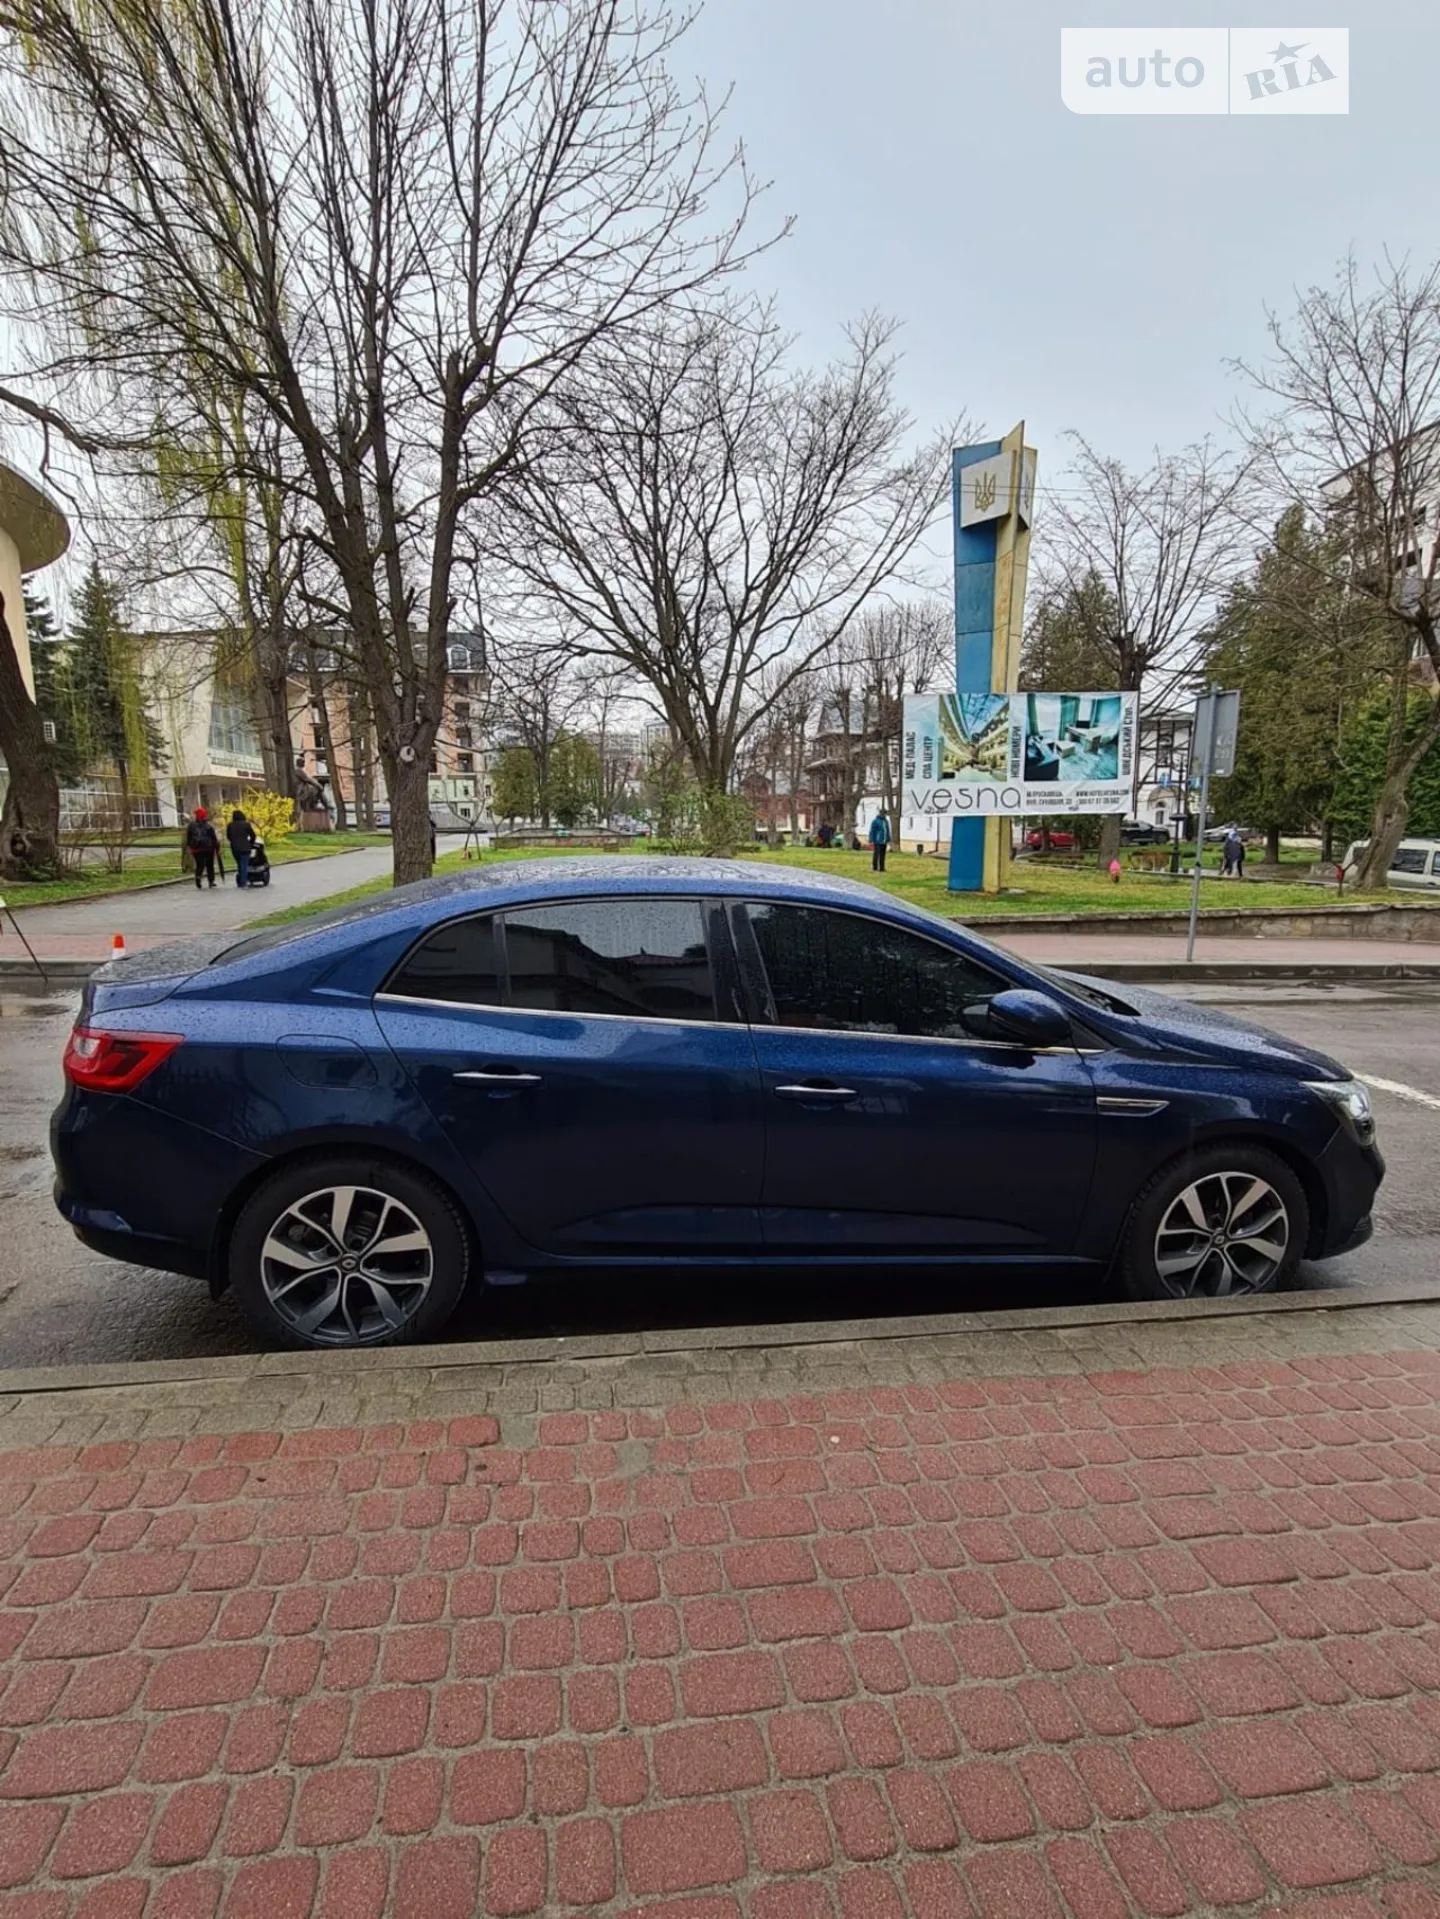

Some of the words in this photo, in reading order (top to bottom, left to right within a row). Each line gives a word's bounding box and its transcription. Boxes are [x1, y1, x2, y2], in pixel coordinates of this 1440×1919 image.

[905, 731, 916, 780] МЕД-ПАЛАС
[923, 735, 934, 762] ЦЕНТР
[1011, 725, 1022, 759] НОМЕРИ
[1121, 726, 1132, 776] ШВЕДСЬКИЙ
[922, 763, 932, 780] СПА
[1010, 760, 1020, 778] НОВІ
[910, 786, 1021, 810] vesna
